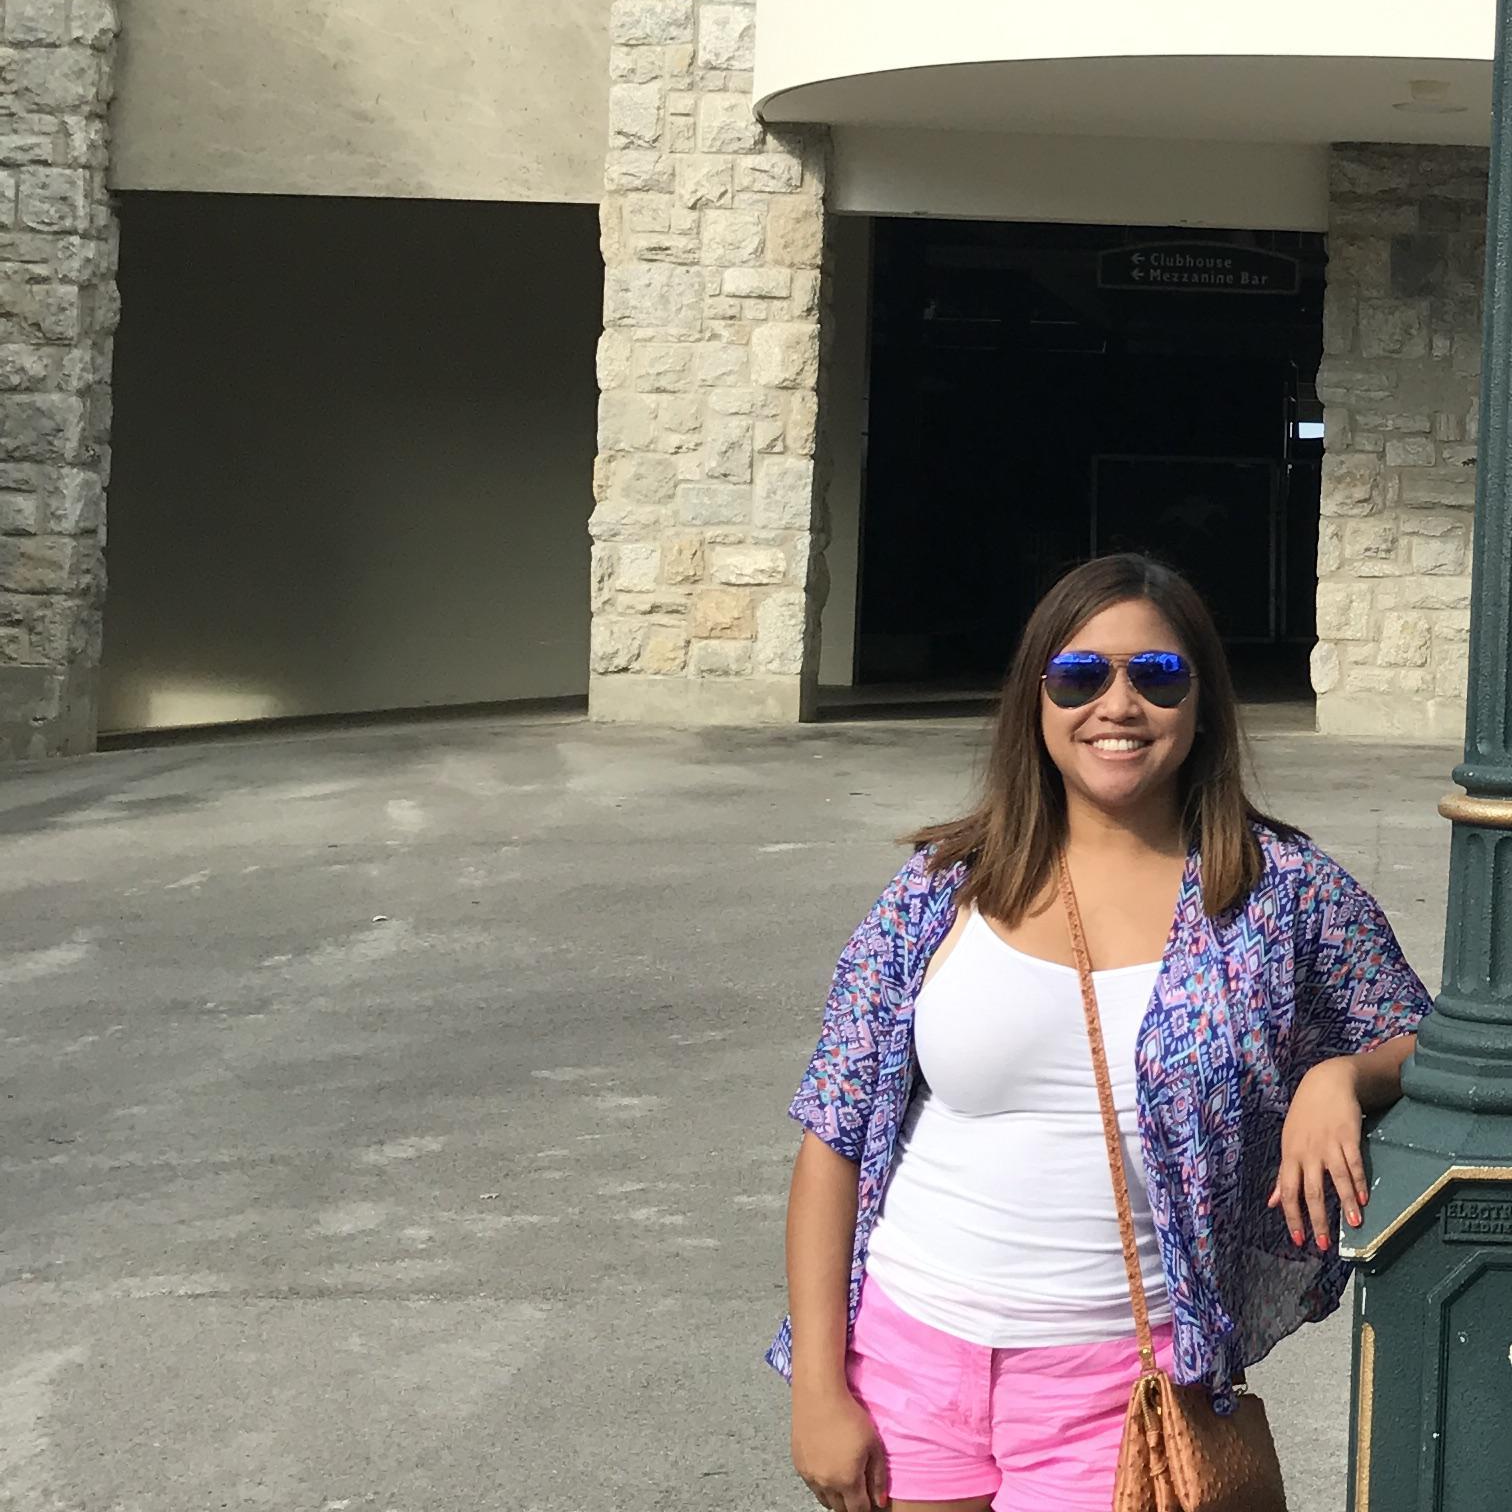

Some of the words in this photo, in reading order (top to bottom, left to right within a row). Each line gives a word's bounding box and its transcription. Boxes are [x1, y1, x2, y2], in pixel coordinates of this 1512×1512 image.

[1149, 252, 1232, 268] Clubhouse
[1149, 268, 1234, 285] Mezzanine
[1240, 271, 1269, 285] Bar
